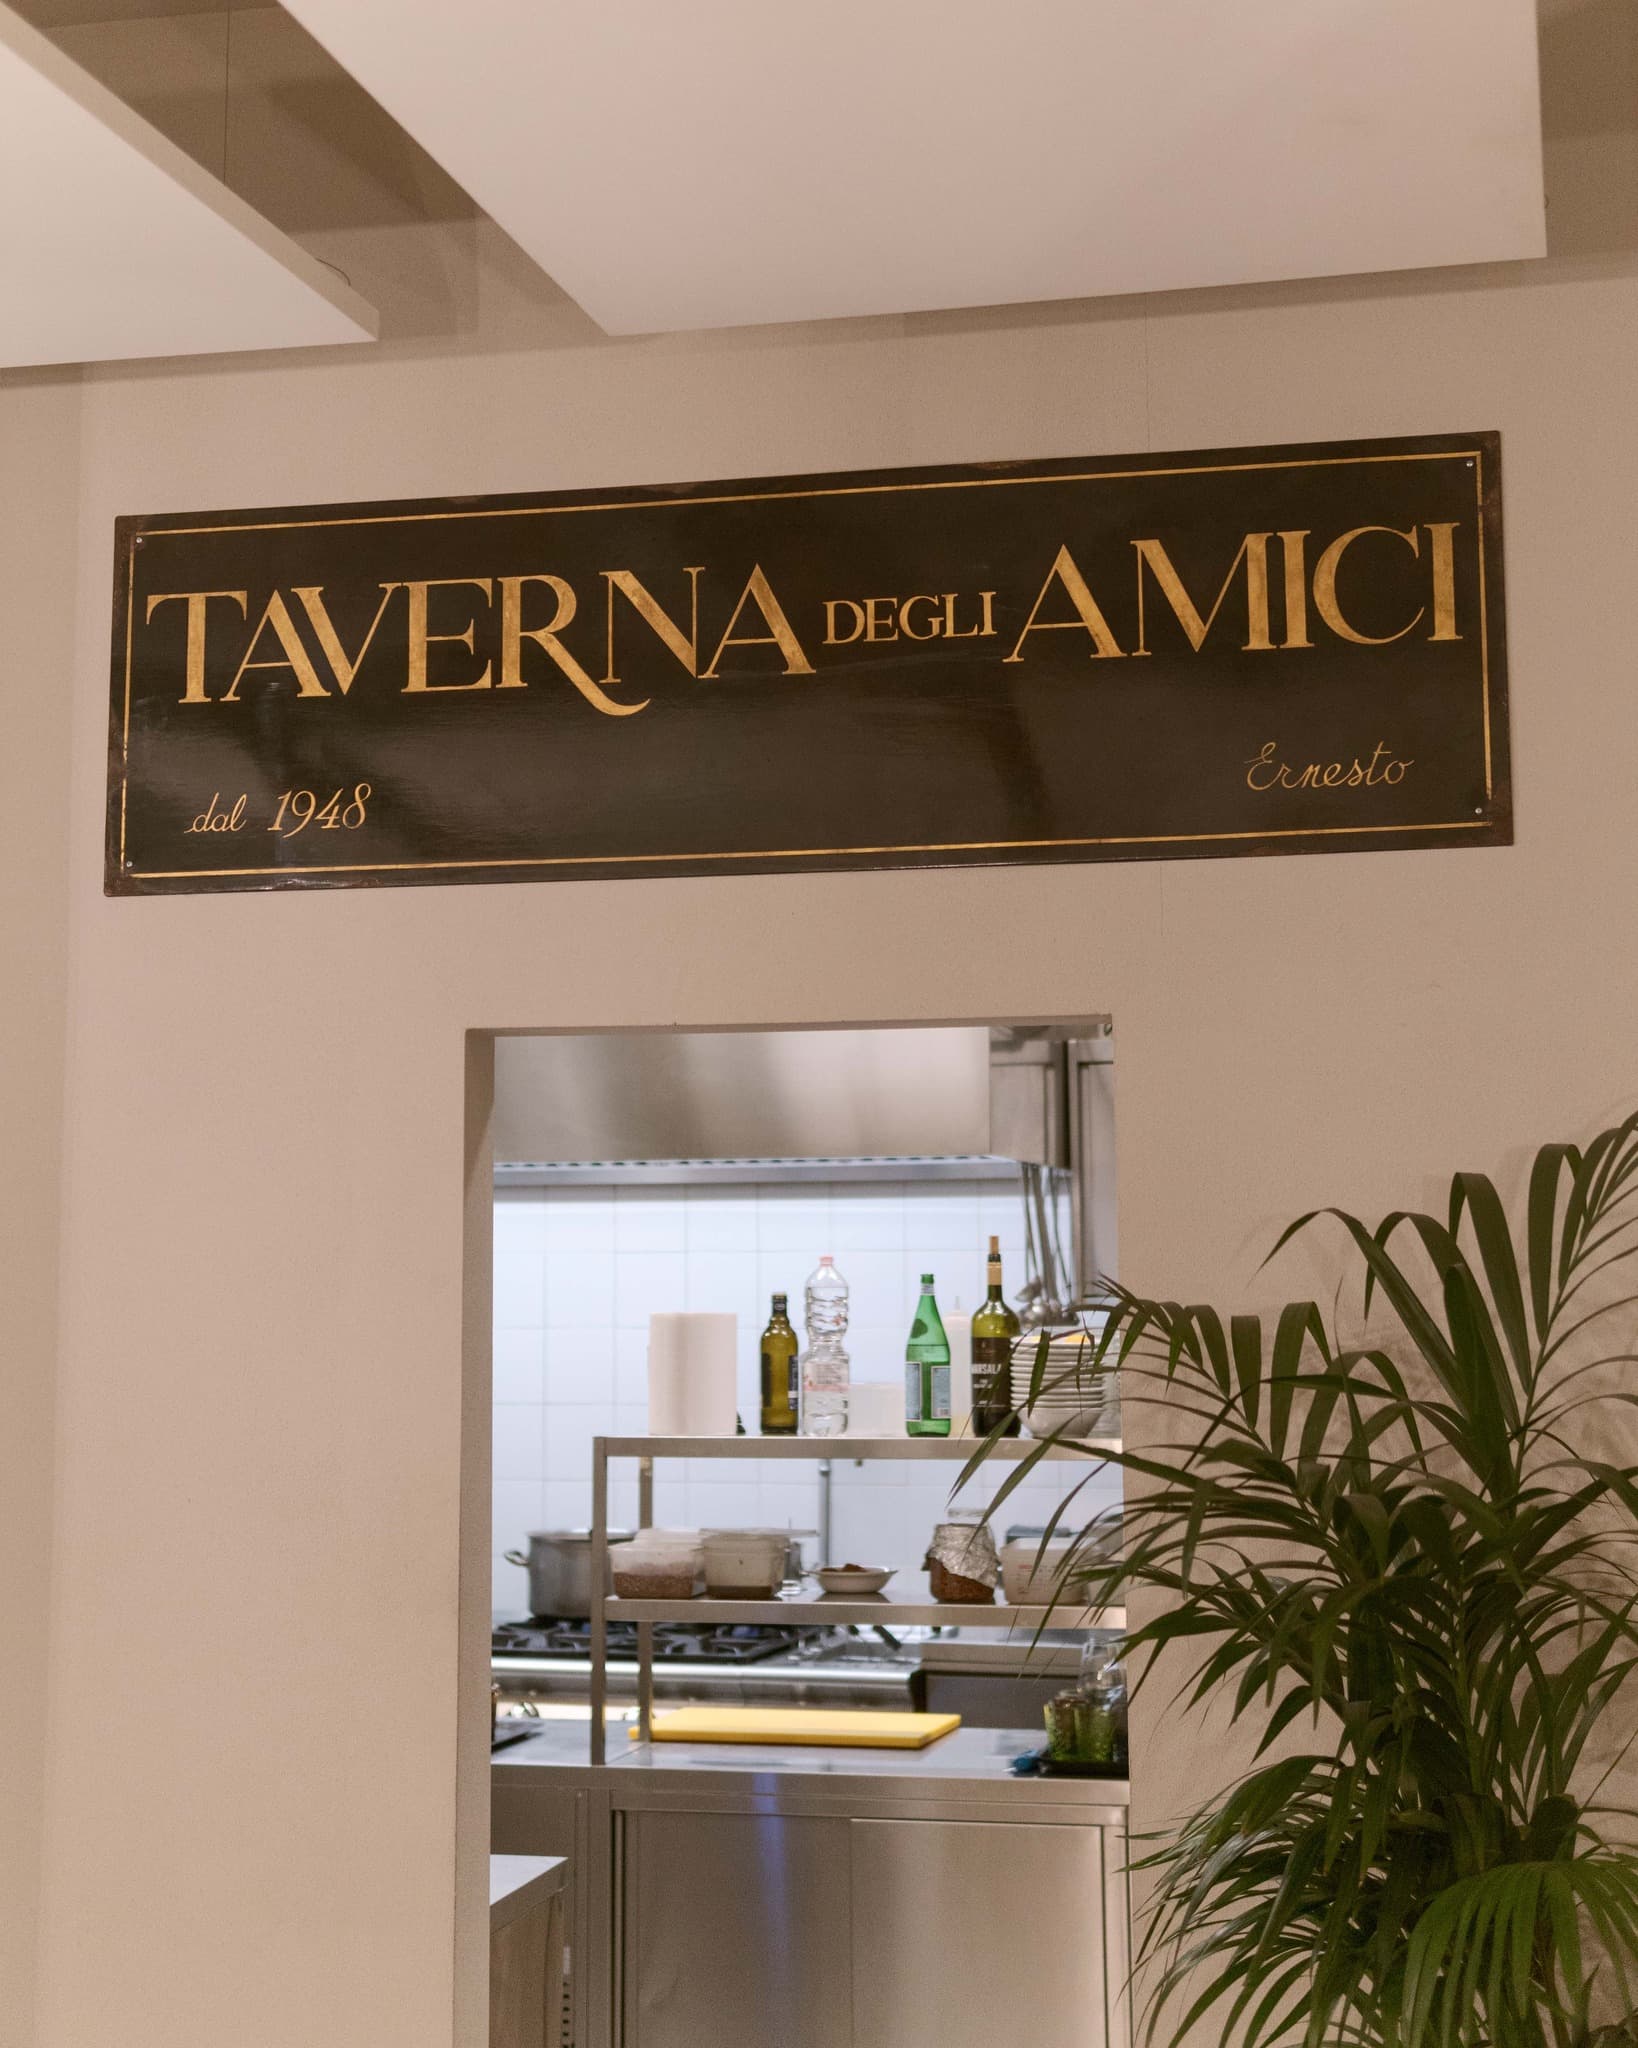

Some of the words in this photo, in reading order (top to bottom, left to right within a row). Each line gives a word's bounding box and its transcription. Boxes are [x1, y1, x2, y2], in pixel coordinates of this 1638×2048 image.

[146, 564, 816, 717] TAVERNA
[823, 591, 998, 645] DEGLI
[1002, 522, 1463, 663] AMICI
[1245, 741, 1415, 791] Ernesto
[185, 791, 249, 834] dal
[267, 782, 373, 839] 1948
